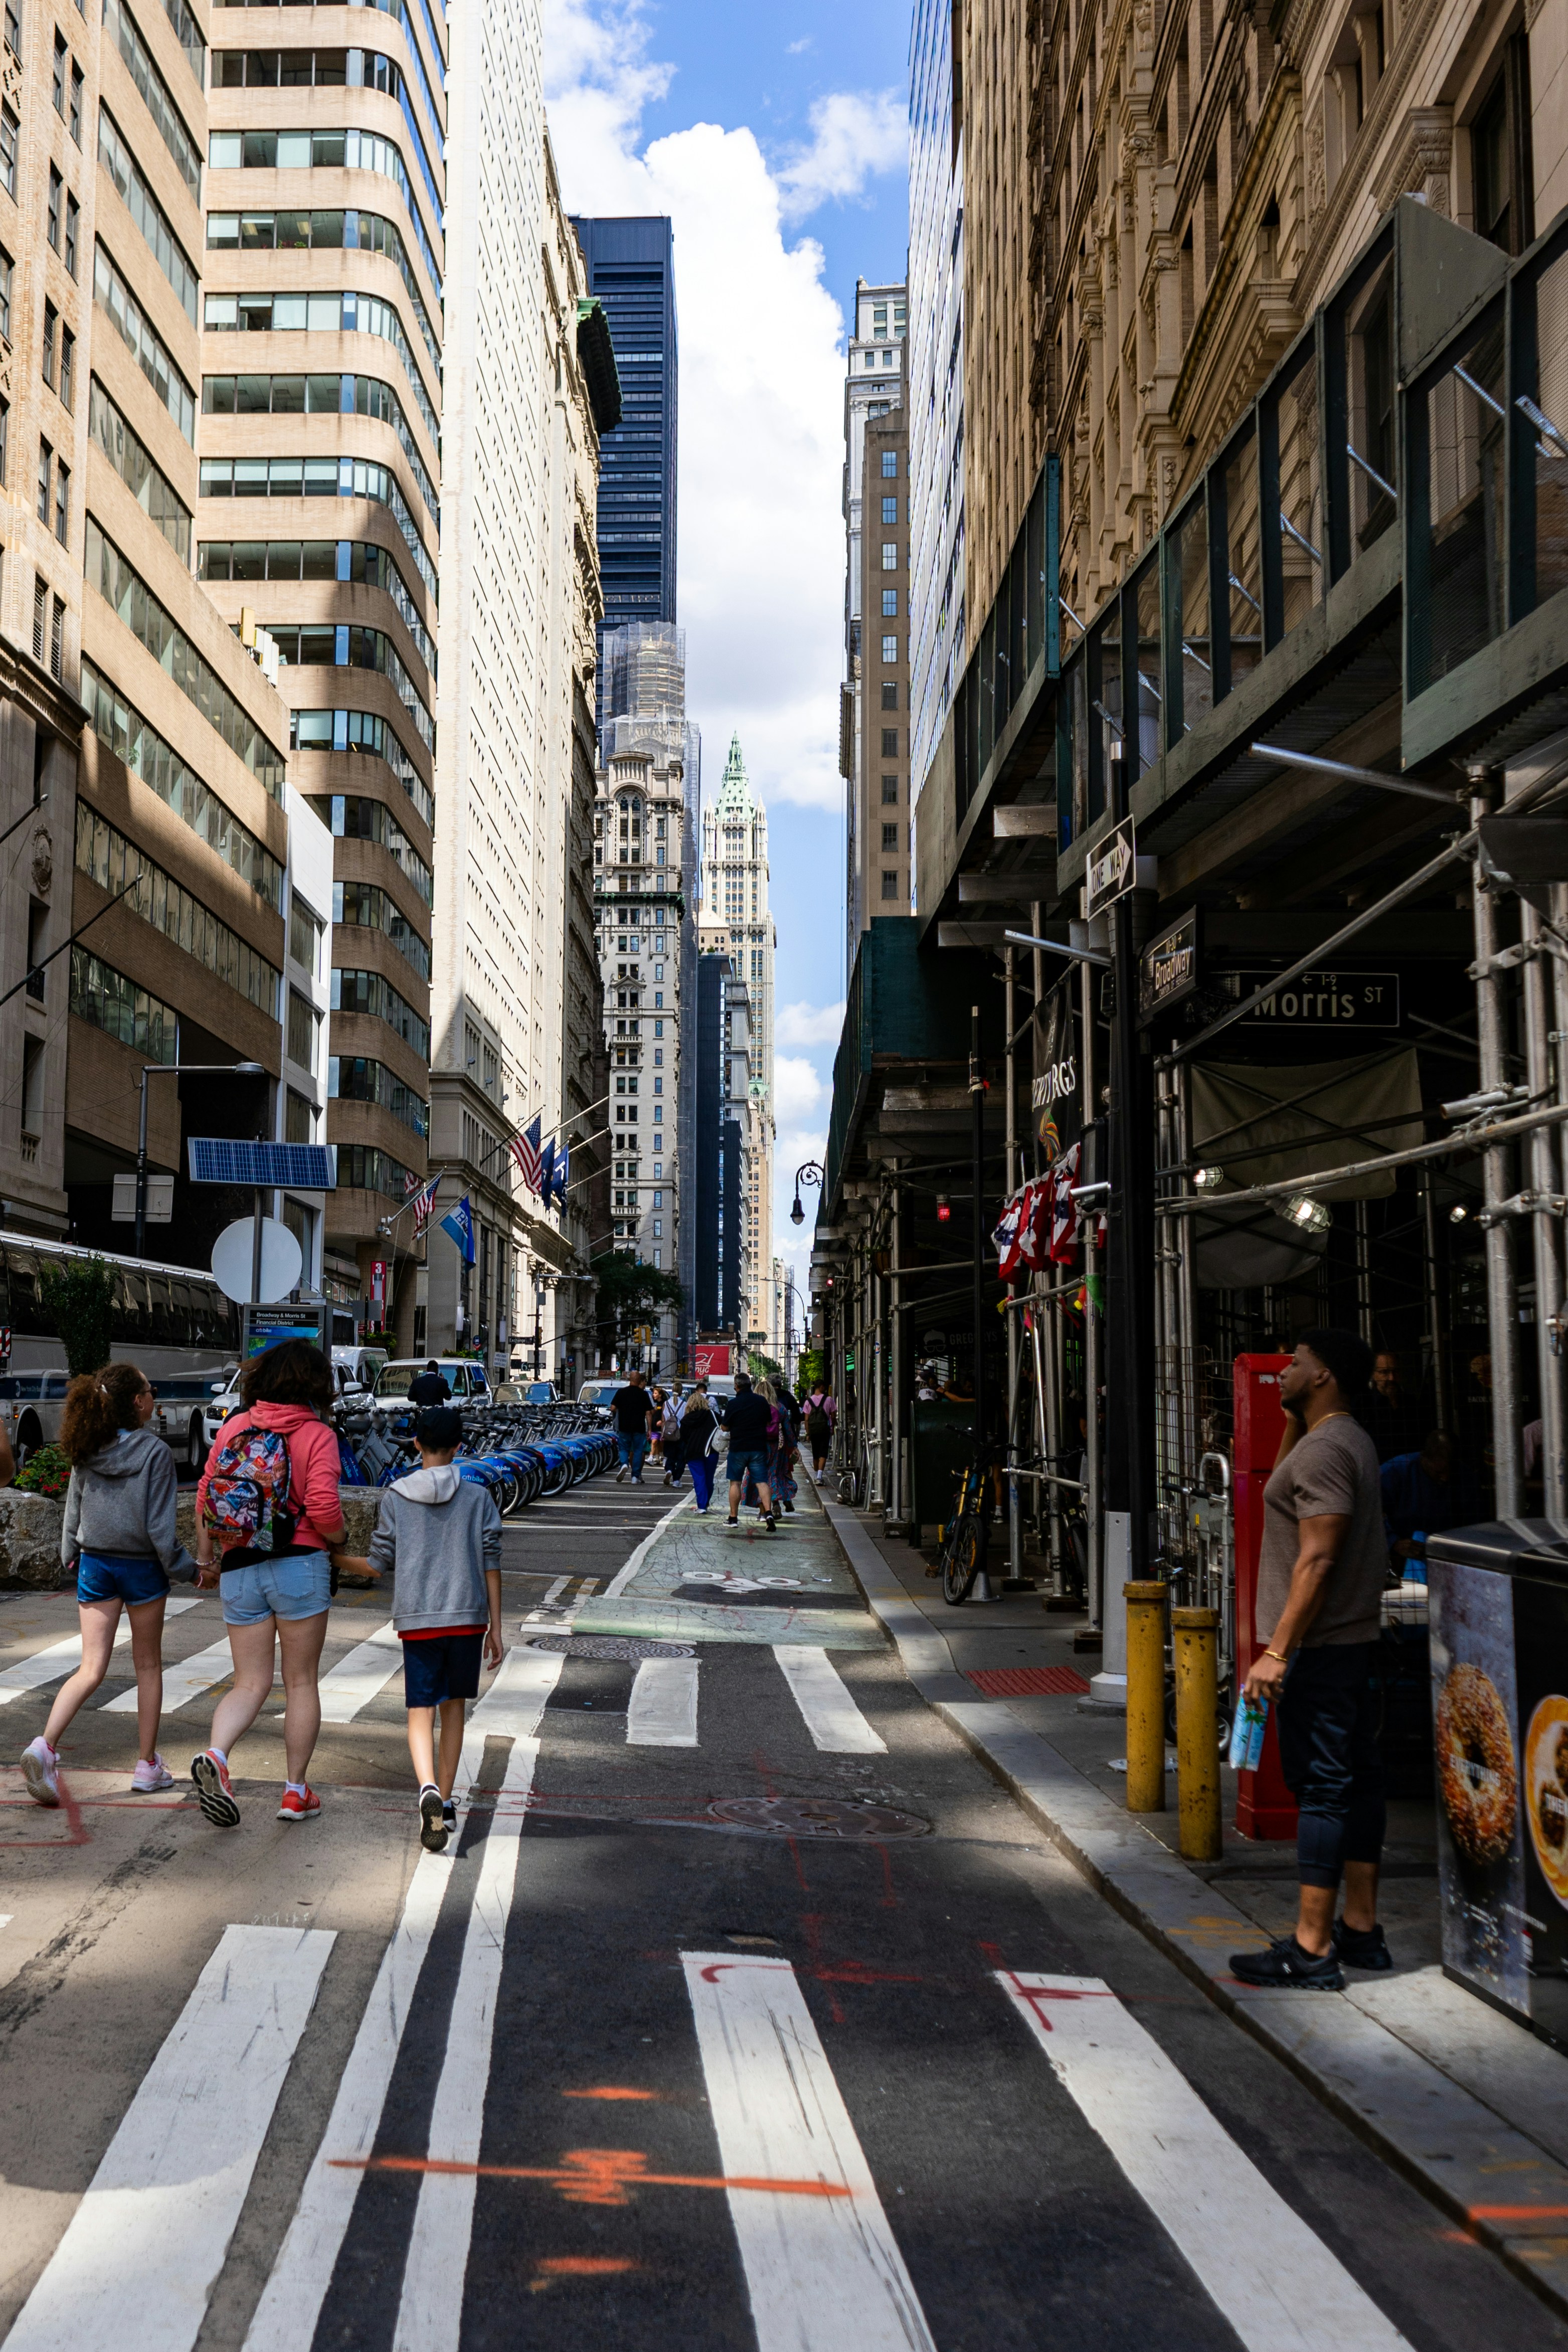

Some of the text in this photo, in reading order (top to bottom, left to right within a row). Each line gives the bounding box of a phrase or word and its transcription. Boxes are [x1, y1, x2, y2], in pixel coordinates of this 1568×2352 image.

[1092, 845, 1126, 894] ONE WAY
[1166, 935, 1177, 955] 10-30
[1155, 946, 1191, 990] Broadway
[1159, 983, 1170, 998] CANYON
[1175, 971, 1187, 985] HEROES
[1320, 974, 1337, 986] 1-9
[1254, 984, 1384, 1019] Morris ST
[695, 1367, 710, 1376] nyc
[472, 1475, 484, 1483] bike
